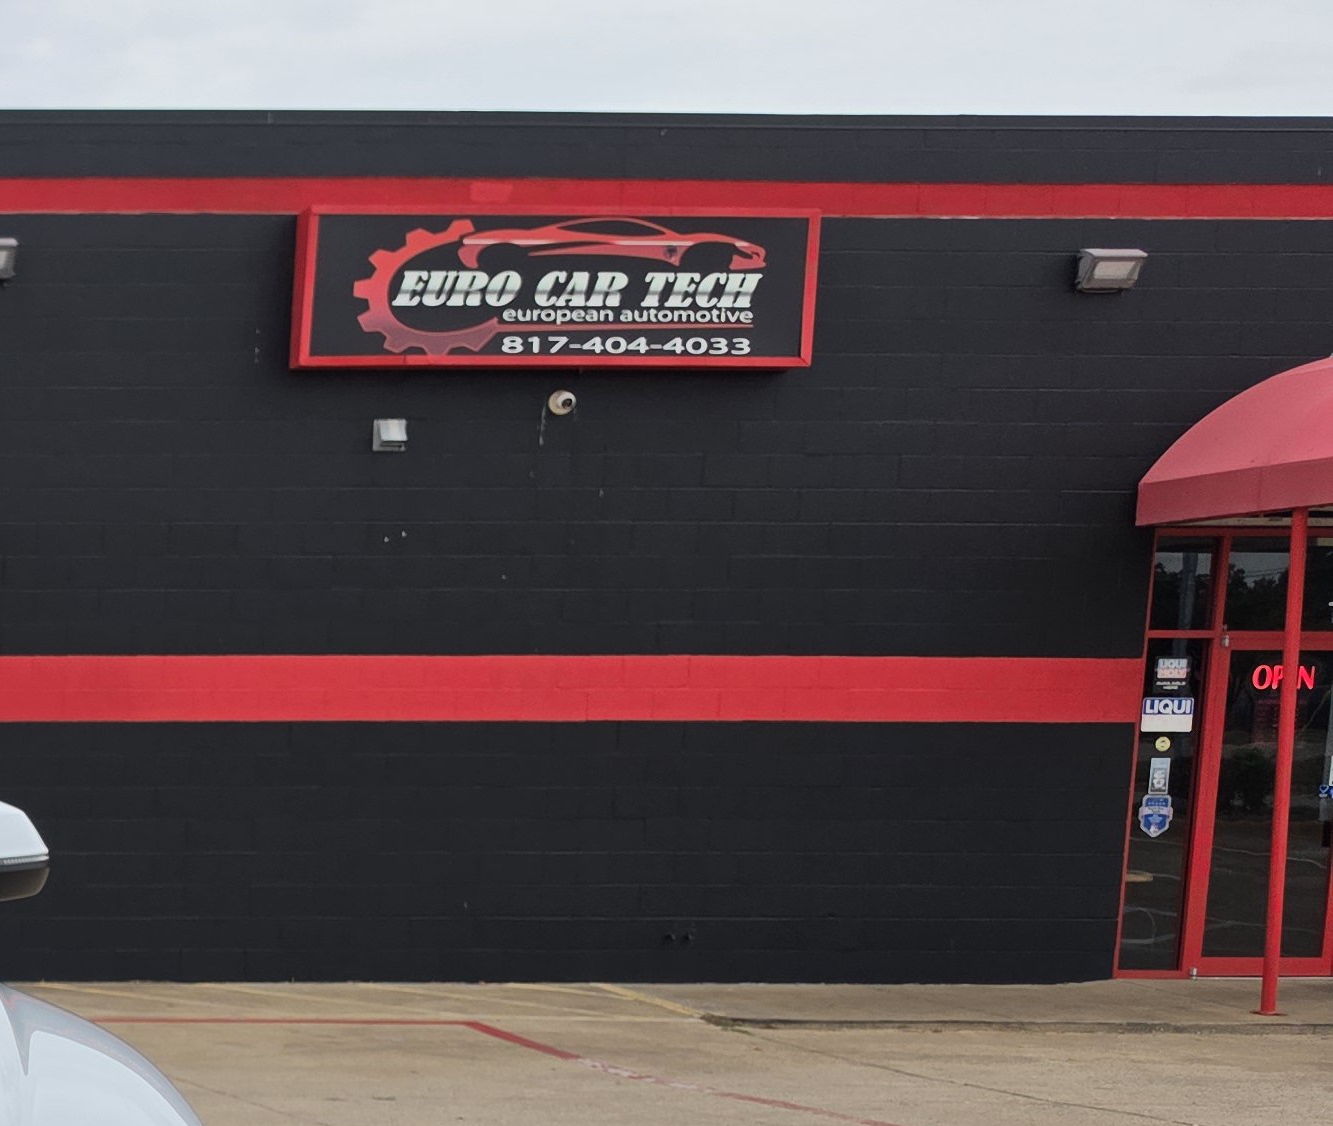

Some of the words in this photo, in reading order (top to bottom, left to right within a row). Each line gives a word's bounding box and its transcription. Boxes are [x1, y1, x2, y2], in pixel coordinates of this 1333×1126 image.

[391, 270, 522, 307] EURO
[534, 271, 629, 307] CAR
[640, 272, 763, 308] TECH
[502, 308, 614, 325] european
[619, 307, 754, 323] automotive
[501, 336, 751, 355] 817-404-4033
[1252, 665, 1315, 689] OPN
[1145, 699, 1192, 714] LIQUI
